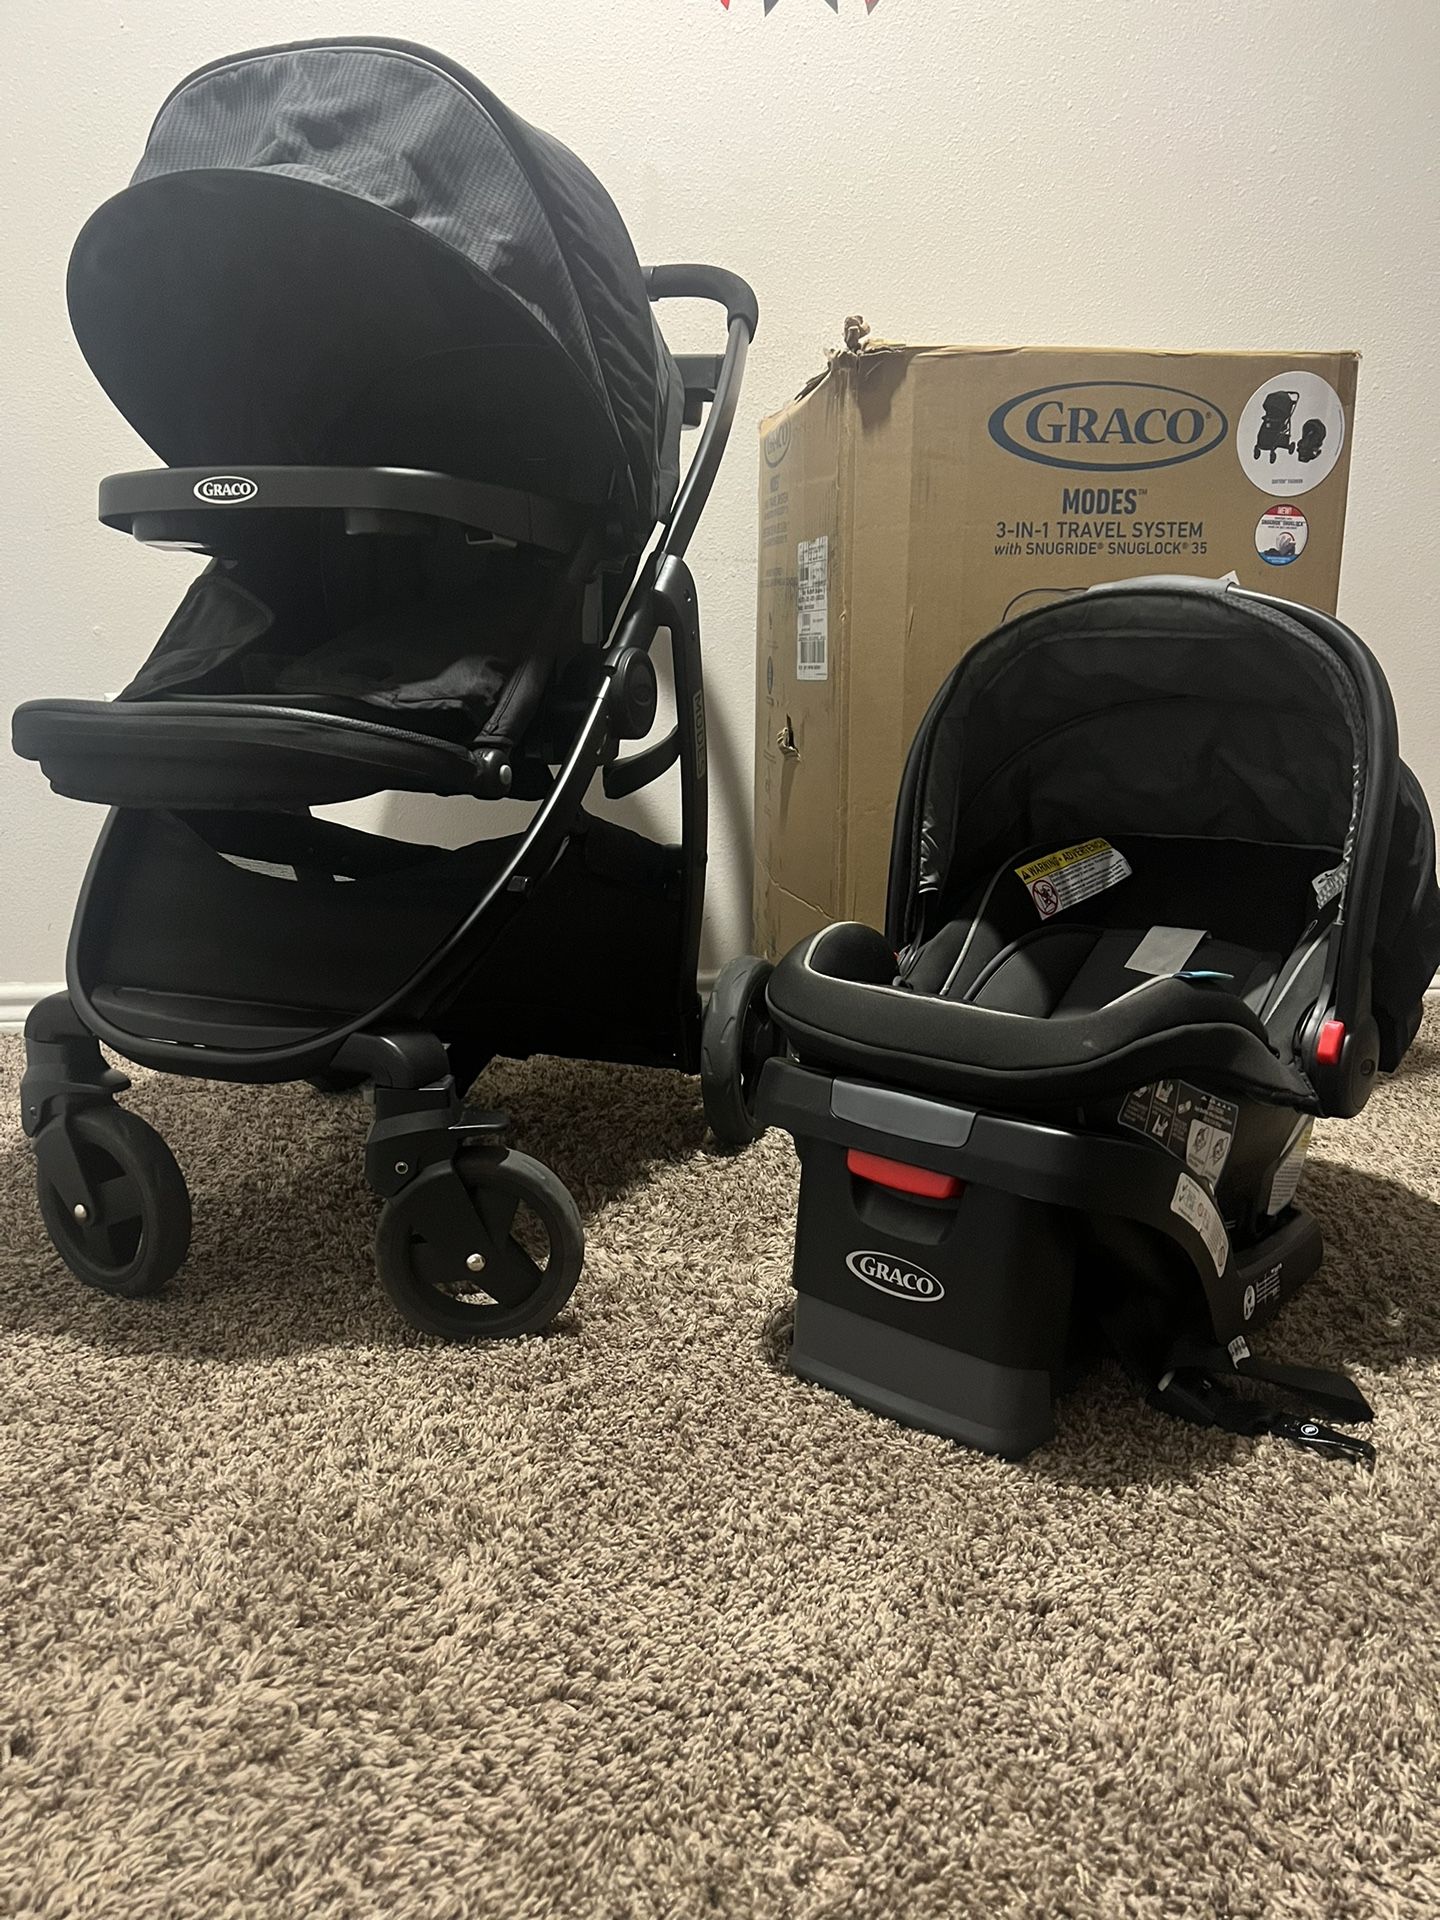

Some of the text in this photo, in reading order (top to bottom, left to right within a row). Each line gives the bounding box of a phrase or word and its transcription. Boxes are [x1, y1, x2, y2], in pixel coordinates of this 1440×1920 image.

[202, 482, 251, 497] GRACO
[996, 521, 1204, 538] 3-IN-1 TRAVEL SYSTEM
[994, 542, 1022, 556] with
[1191, 541, 1208, 554] 35
[1028, 856, 1060, 876] WARNING
[859, 1256, 934, 1295] GRACO
